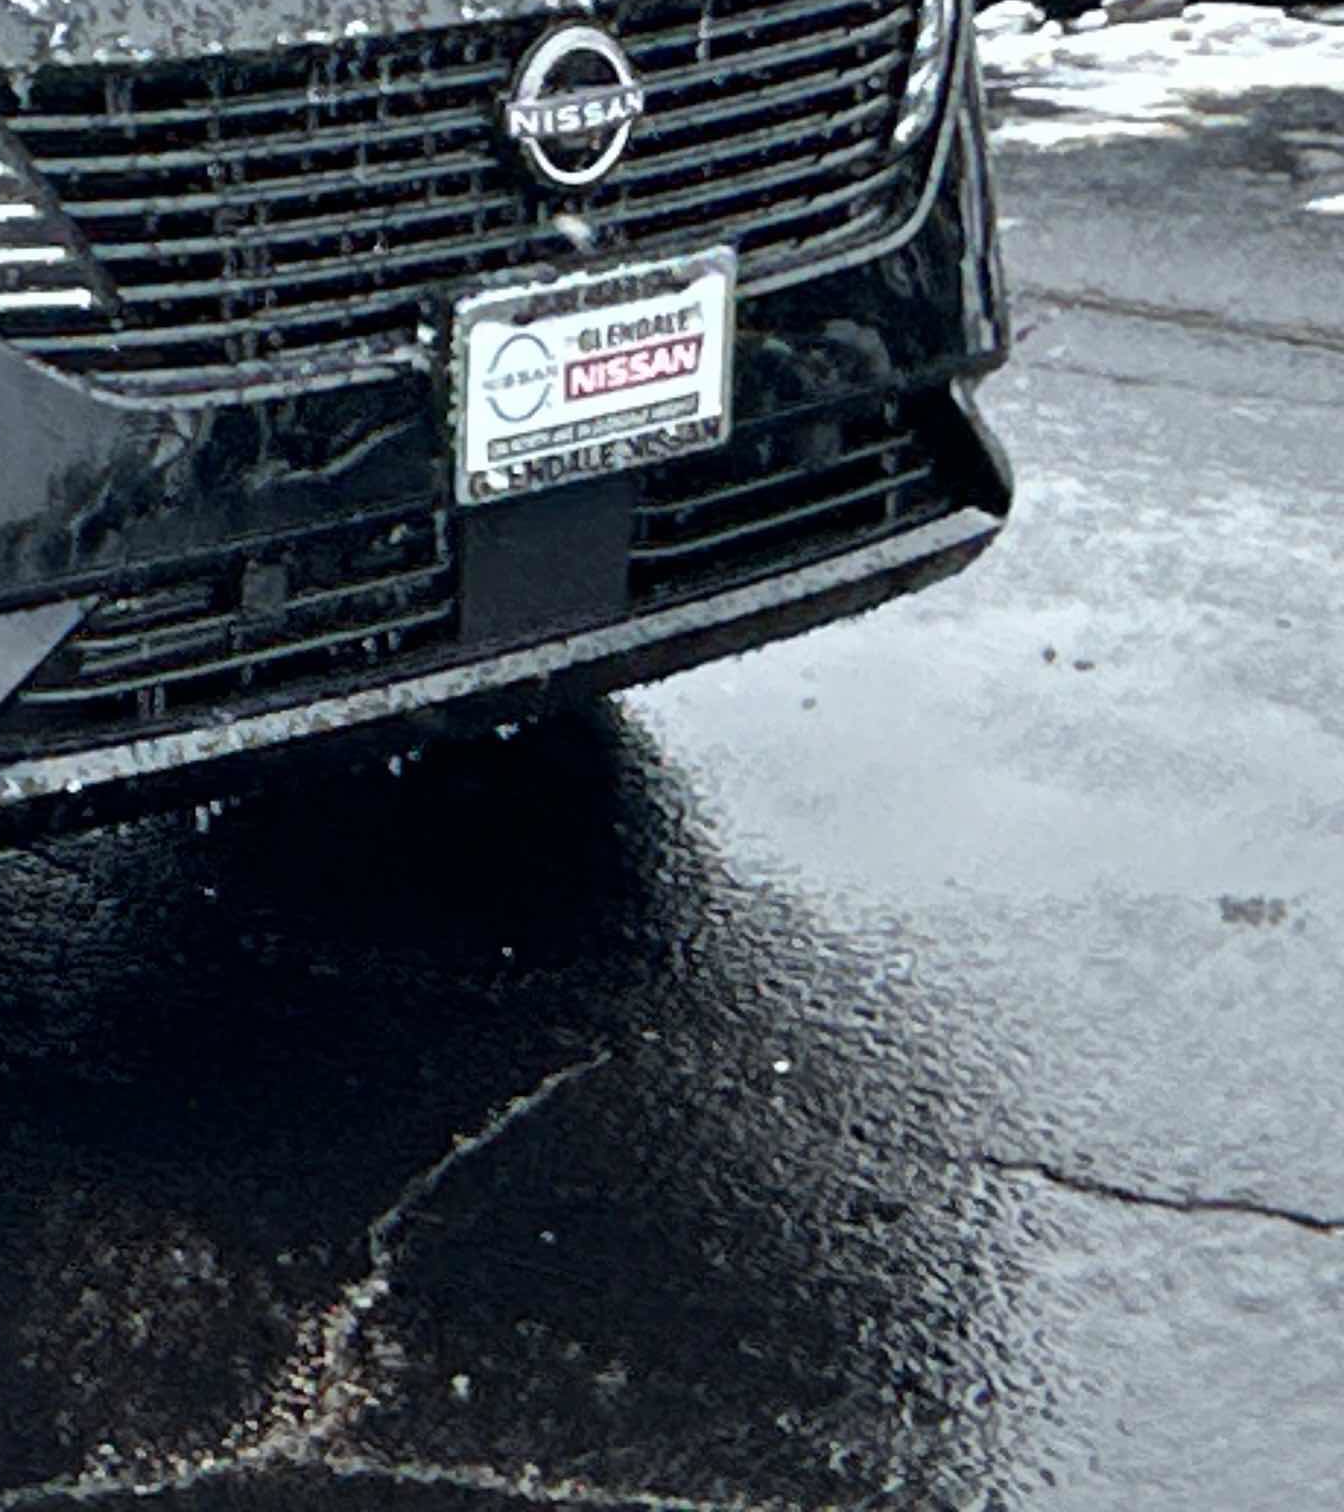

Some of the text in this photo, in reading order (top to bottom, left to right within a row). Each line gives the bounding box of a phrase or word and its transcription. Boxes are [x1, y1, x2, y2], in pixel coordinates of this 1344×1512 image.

[509, 89, 644, 137] NISSAN
[577, 309, 691, 353] GLENDALE
[569, 342, 698, 397] NISSAN
